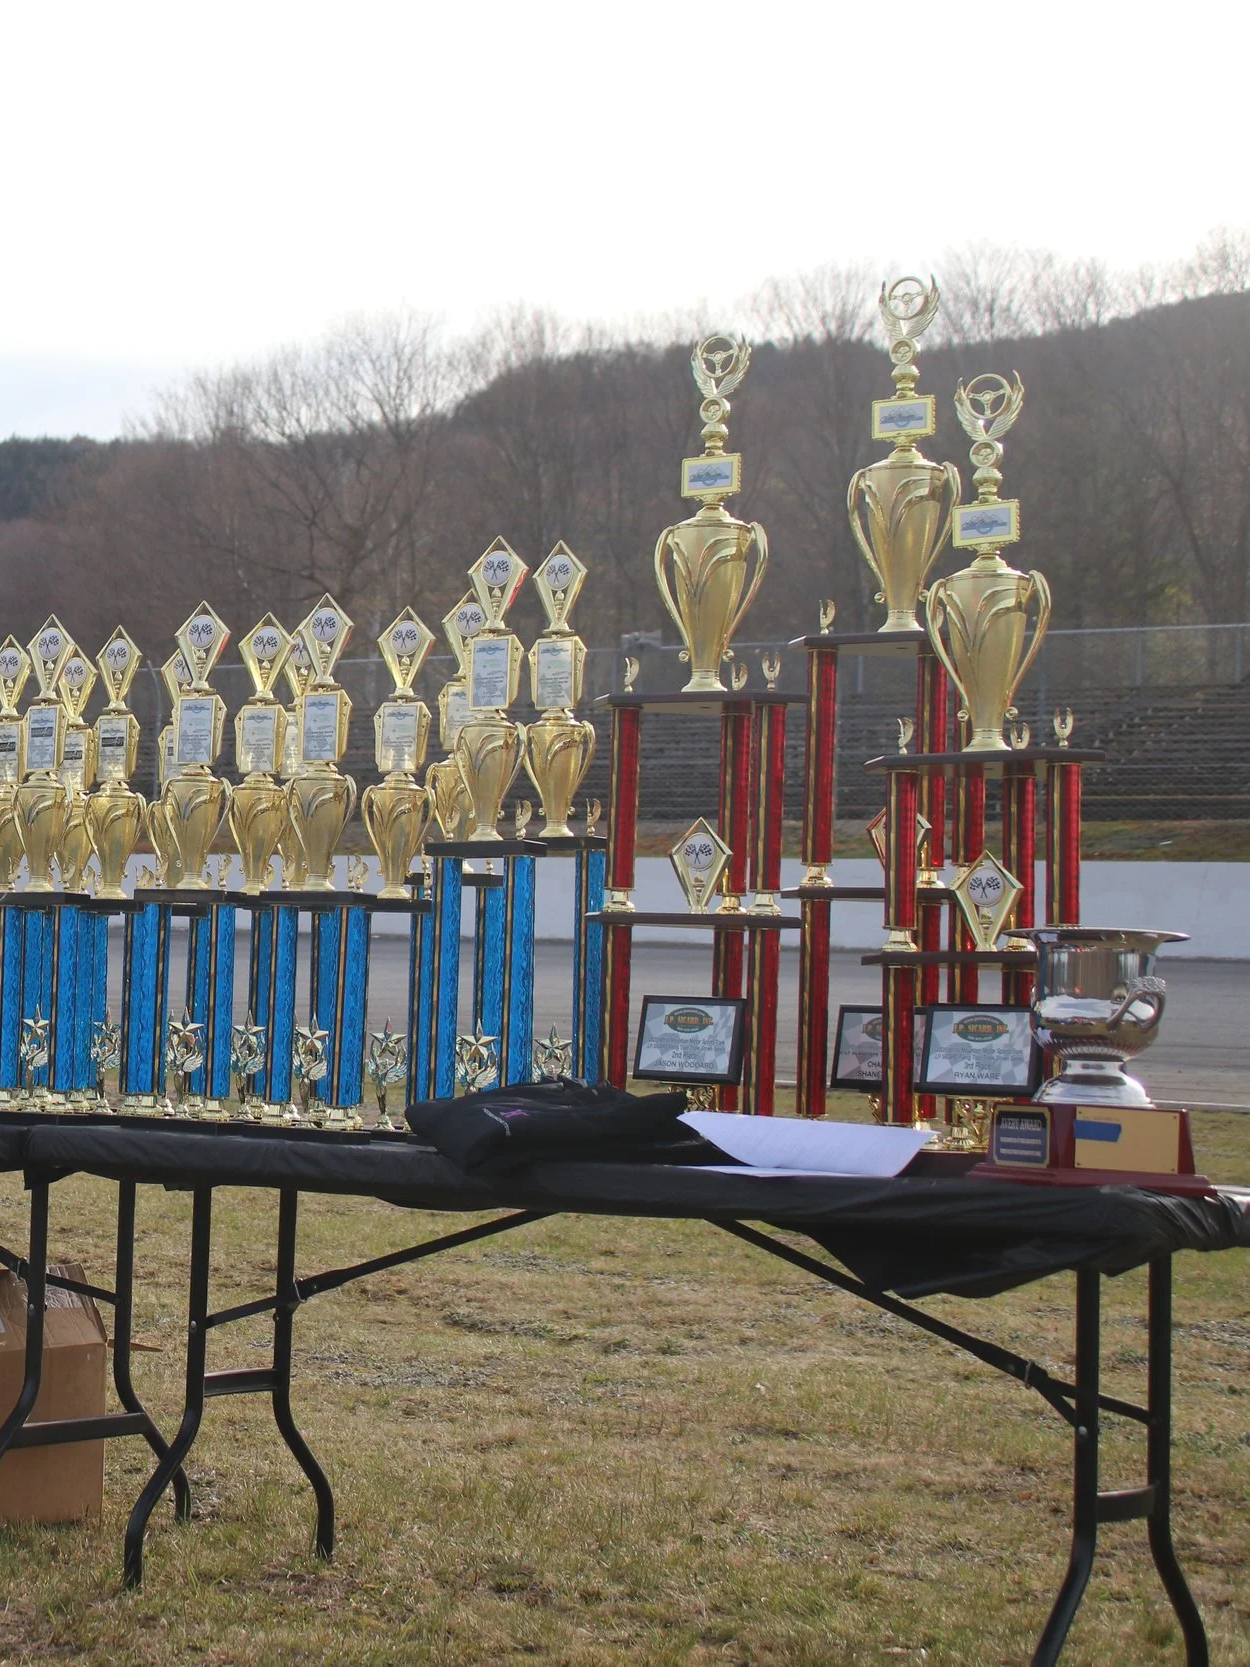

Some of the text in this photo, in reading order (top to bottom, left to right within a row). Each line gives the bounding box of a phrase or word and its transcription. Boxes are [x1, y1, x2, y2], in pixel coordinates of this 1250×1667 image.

[672, 1051, 682, 1060] 2nd
[653, 1060, 677, 1068] JASON
[963, 1061, 992, 1071] 3rd Place
[857, 1070, 882, 1079] SHANE
[954, 1071, 976, 1080] RYAN
[1019, 1118, 1042, 1132] AWARD
